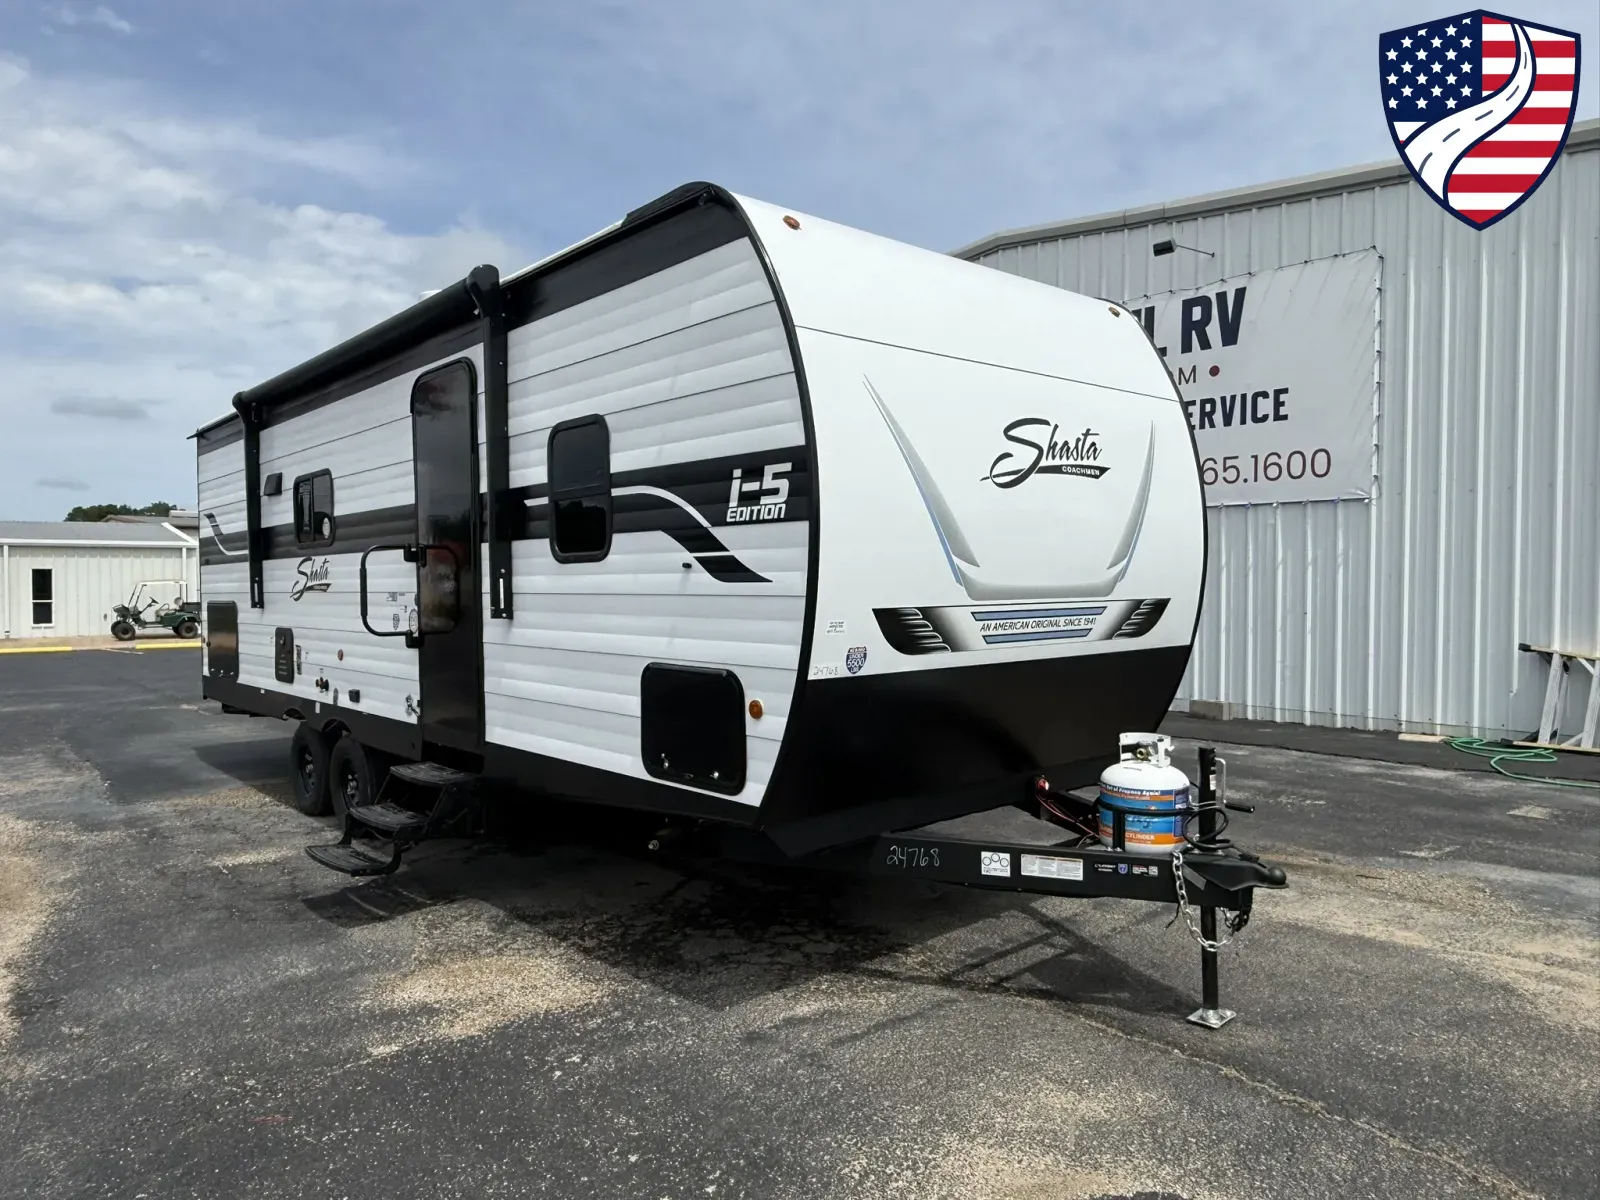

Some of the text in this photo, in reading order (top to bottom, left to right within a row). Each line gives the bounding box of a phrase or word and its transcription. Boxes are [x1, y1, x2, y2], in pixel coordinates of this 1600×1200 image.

[1180, 286, 1247, 354] RV
[989, 417, 1103, 489] Shasta
[1061, 465, 1100, 476] COACHMEN
[728, 461, 793, 508] i-5
[726, 503, 786, 523] EDITION
[290, 556, 331, 602] Shasta
[980, 616, 1097, 632] AN AMERICAN ORIGINAL SINCE 1941
[813, 666, 839, 676] 24768
[886, 844, 940, 868] 24768
